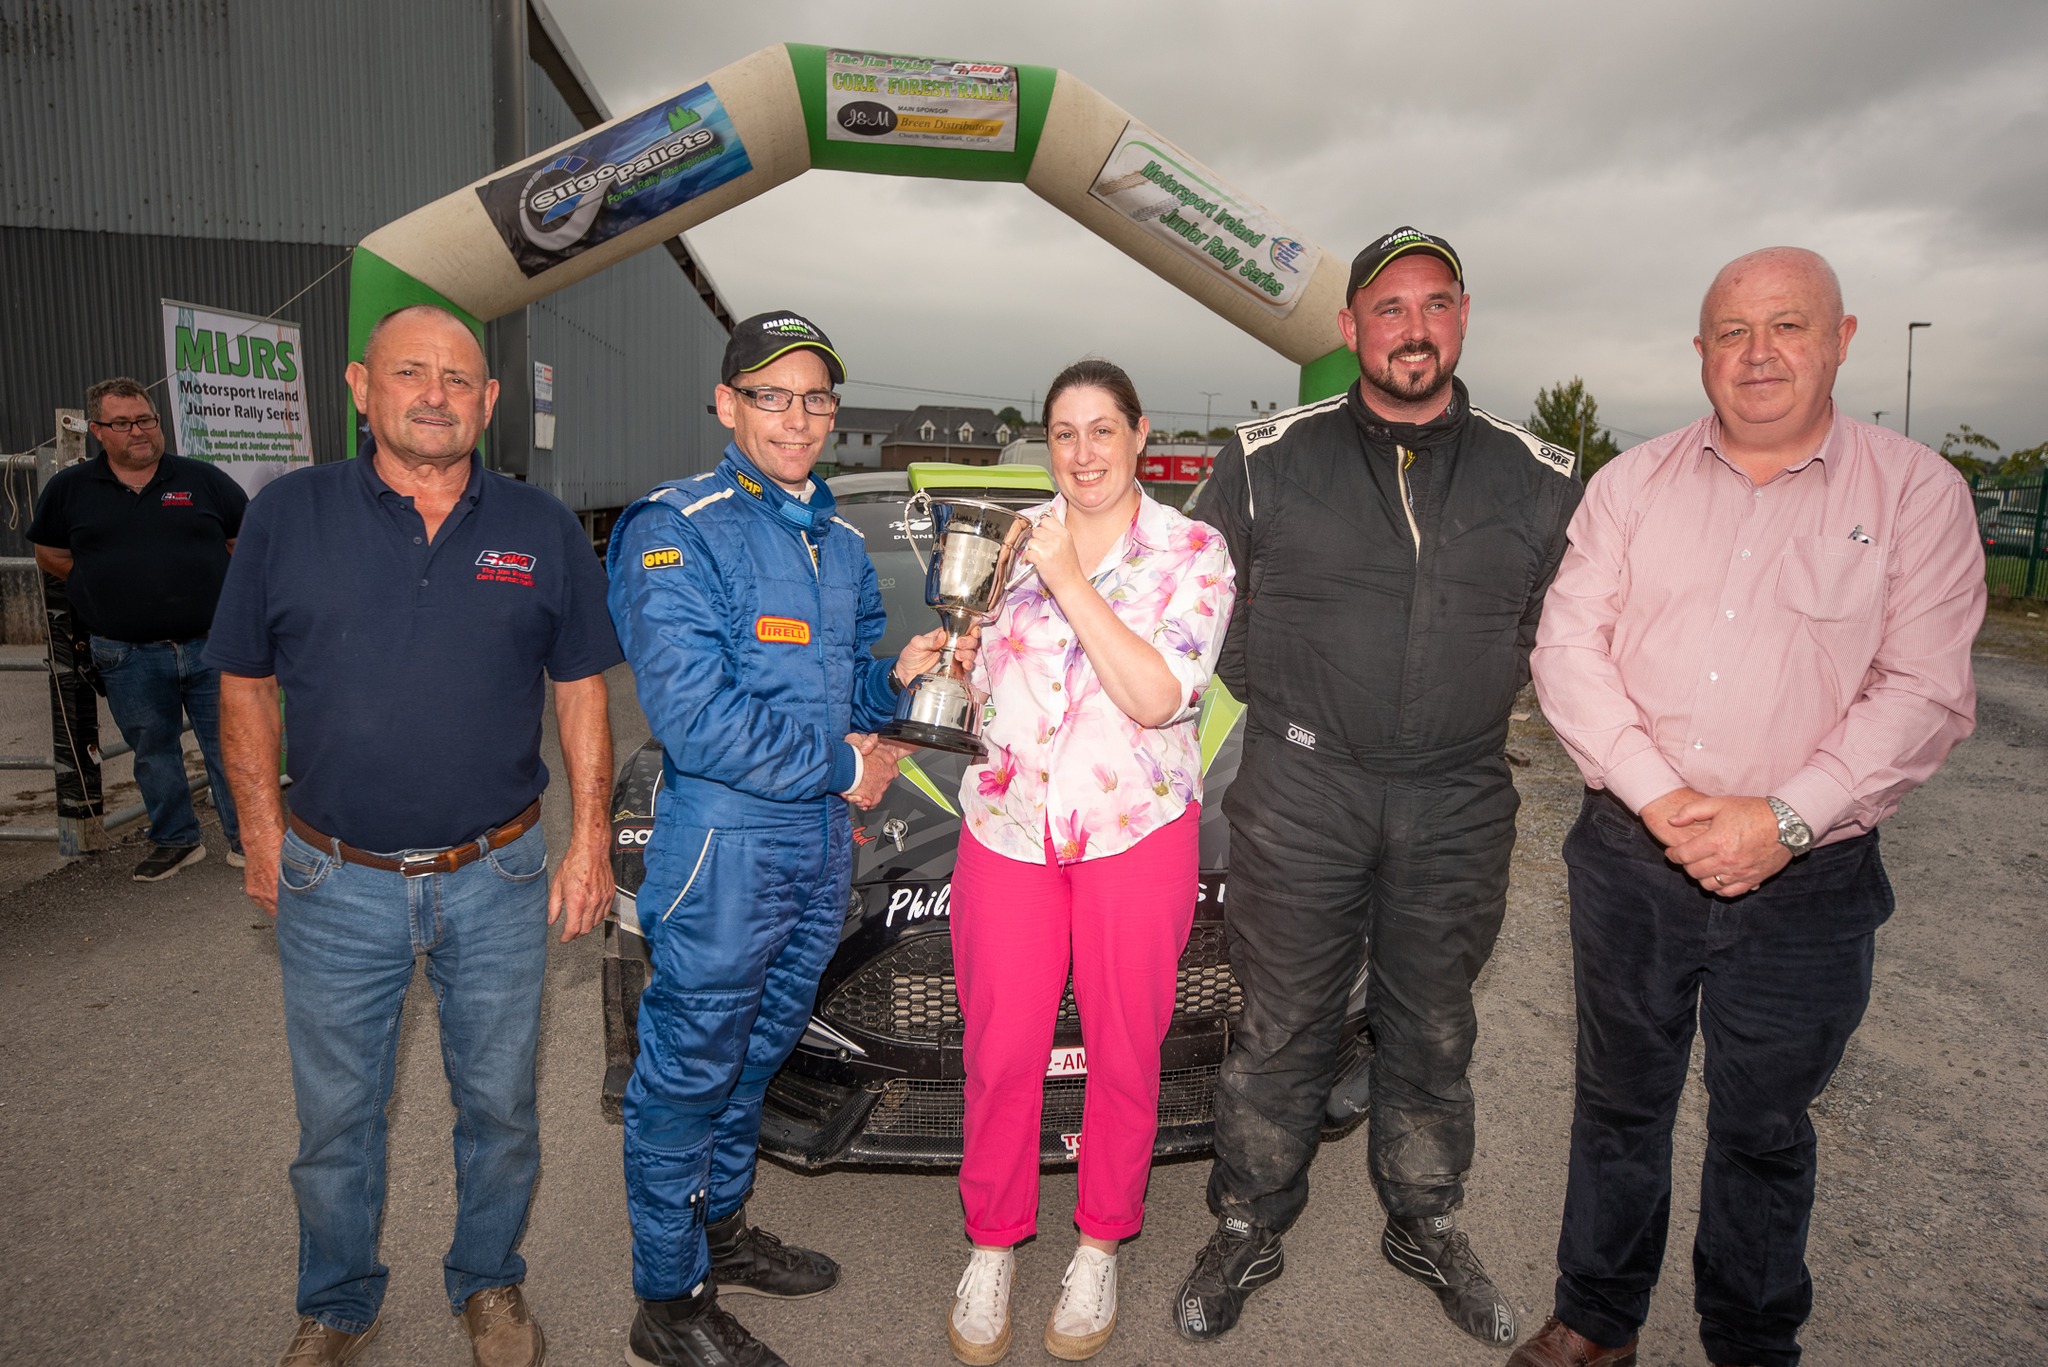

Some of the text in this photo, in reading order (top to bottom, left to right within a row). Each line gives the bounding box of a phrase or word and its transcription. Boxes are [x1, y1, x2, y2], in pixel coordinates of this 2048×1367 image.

[833, 53, 859, 64] The
[860, 55, 887, 67] Jim
[832, 72, 1010, 101] CORK FOREST RALLY
[844, 108, 890, 128] J&M
[901, 117, 995, 132] Breen Distributors
[607, 143, 726, 205] Forest Rally Championship
[1140, 160, 1265, 248] Motorsport Ireland
[1159, 208, 1209, 245] Junior
[1202, 235, 1243, 271] Rally
[1239, 259, 1285, 297] Series
[175, 325, 297, 382] MIJRS
[179, 380, 299, 402] Motorsport Ireland
[186, 402, 300, 423] Junior Rally Series
[1247, 426, 1276, 441] OMP
[1540, 447, 1569, 465] OMP
[738, 475, 760, 494] OMP
[644, 550, 679, 566] OMP
[761, 621, 804, 639] PIRELLI
[1287, 727, 1316, 745] OMP
[1226, 1217, 1249, 1230] OMP
[1435, 1216, 1453, 1228] OMP
[1186, 1299, 1203, 1331] OMP
